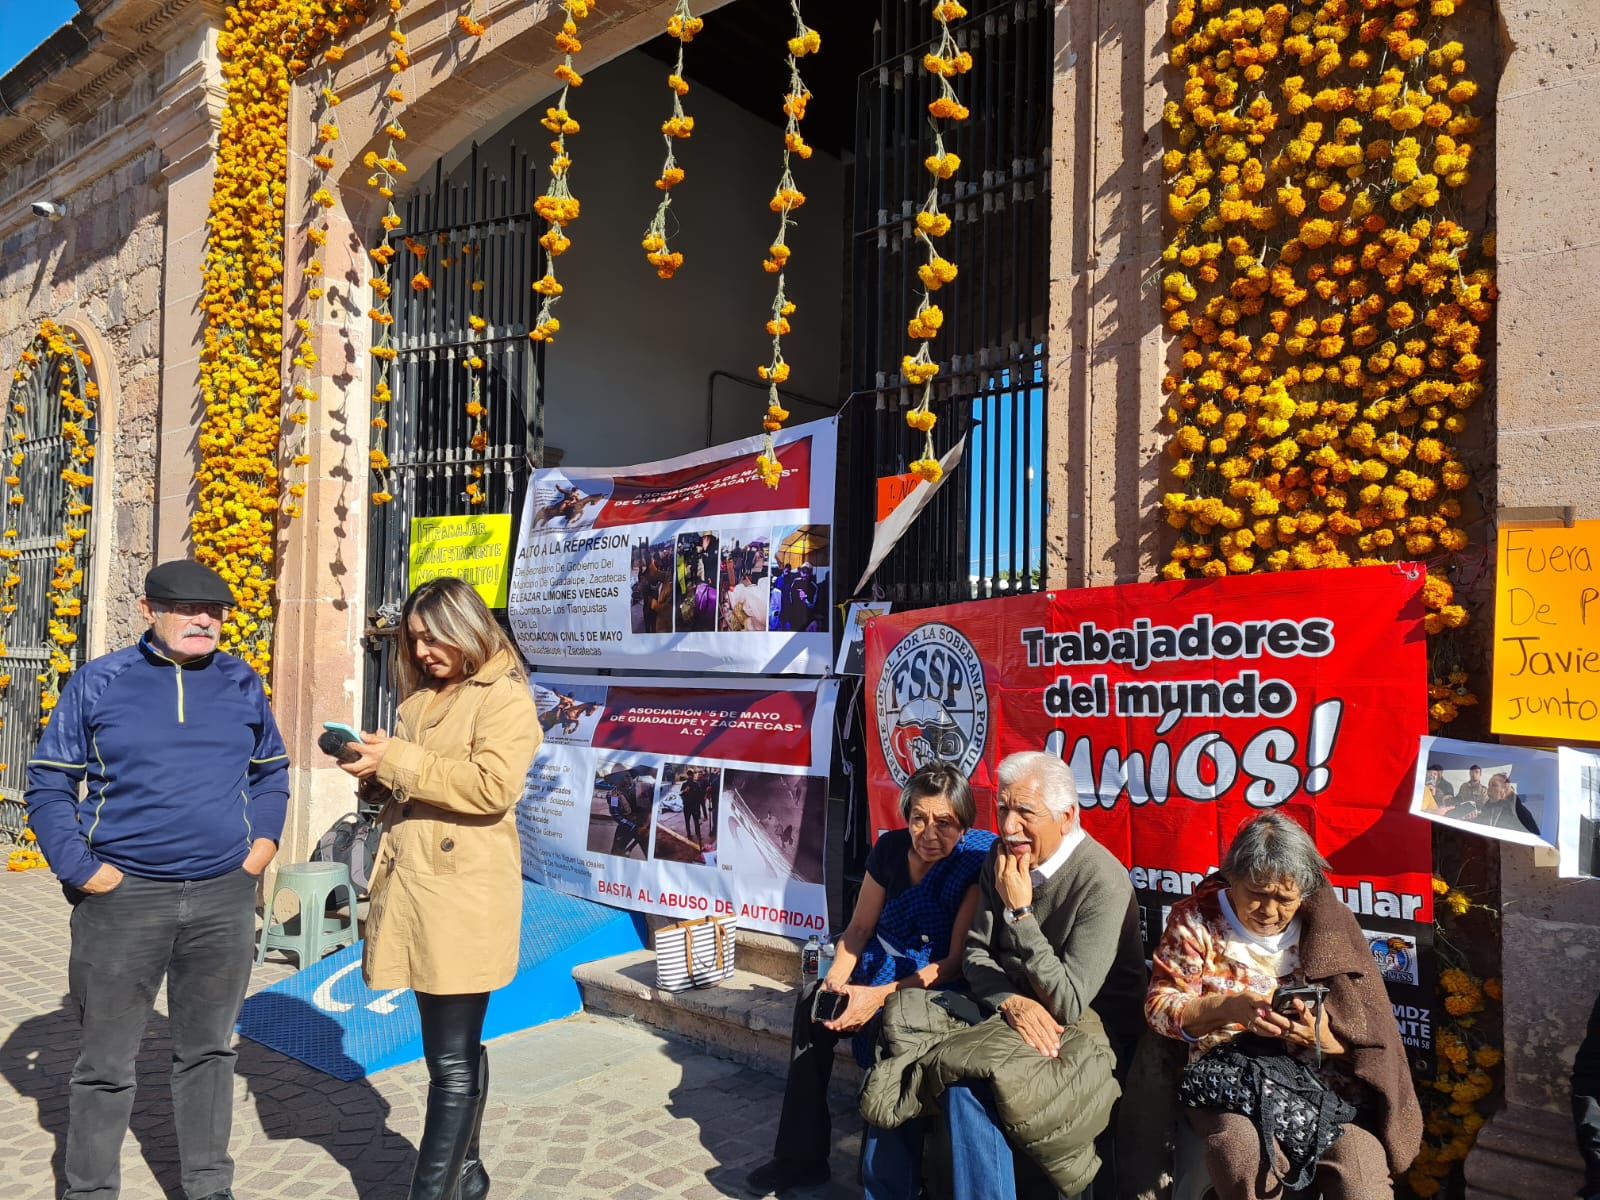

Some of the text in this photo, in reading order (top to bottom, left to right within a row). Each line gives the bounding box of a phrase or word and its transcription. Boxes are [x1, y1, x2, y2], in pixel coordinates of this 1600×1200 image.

[723, 473, 738, 482] DE
[614, 499, 628, 507] DE
[632, 489, 699, 505] GUADALUPE
[518, 534, 630, 559] ALTO A LA REPRESION
[1506, 529, 1592, 576] Fuera
[555, 562, 565, 573] De
[566, 560, 599, 572] Gobierno
[601, 559, 614, 569] Del
[589, 573, 627, 584] Zacatecas
[511, 587, 619, 603] ELEAZAR LIMONES VENEGAS
[519, 605, 541, 616] Contra
[541, 605, 552, 615] De
[553, 604, 565, 614] Los
[566, 603, 608, 616] Tianguistas
[1508, 587, 1557, 626] De
[560, 631, 579, 641] CIVIL
[580, 632, 585, 642] 5
[586, 631, 598, 641] DE
[600, 630, 623, 641] MAYO
[896, 634, 920, 657] POR
[922, 627, 937, 640] LA
[1021, 613, 1335, 671] Trabajadores
[567, 646, 602, 656] Zacatecas
[891, 648, 964, 709] FSSP
[878, 658, 895, 717] SOCIAL
[1043, 669, 1298, 718] del mundo
[610, 714, 625, 723] DE
[627, 715, 698, 726] GUADALUPE
[700, 718, 708, 726] Y
[719, 709, 737, 718] DE
[740, 711, 780, 721] MAYO
[680, 727, 706, 737] A.C.
[547, 785, 571, 795] Mercados
[541, 805, 563, 817] Municipal
[598, 879, 825, 931] BASTA AL ABUSO DE AUTORIDAD
